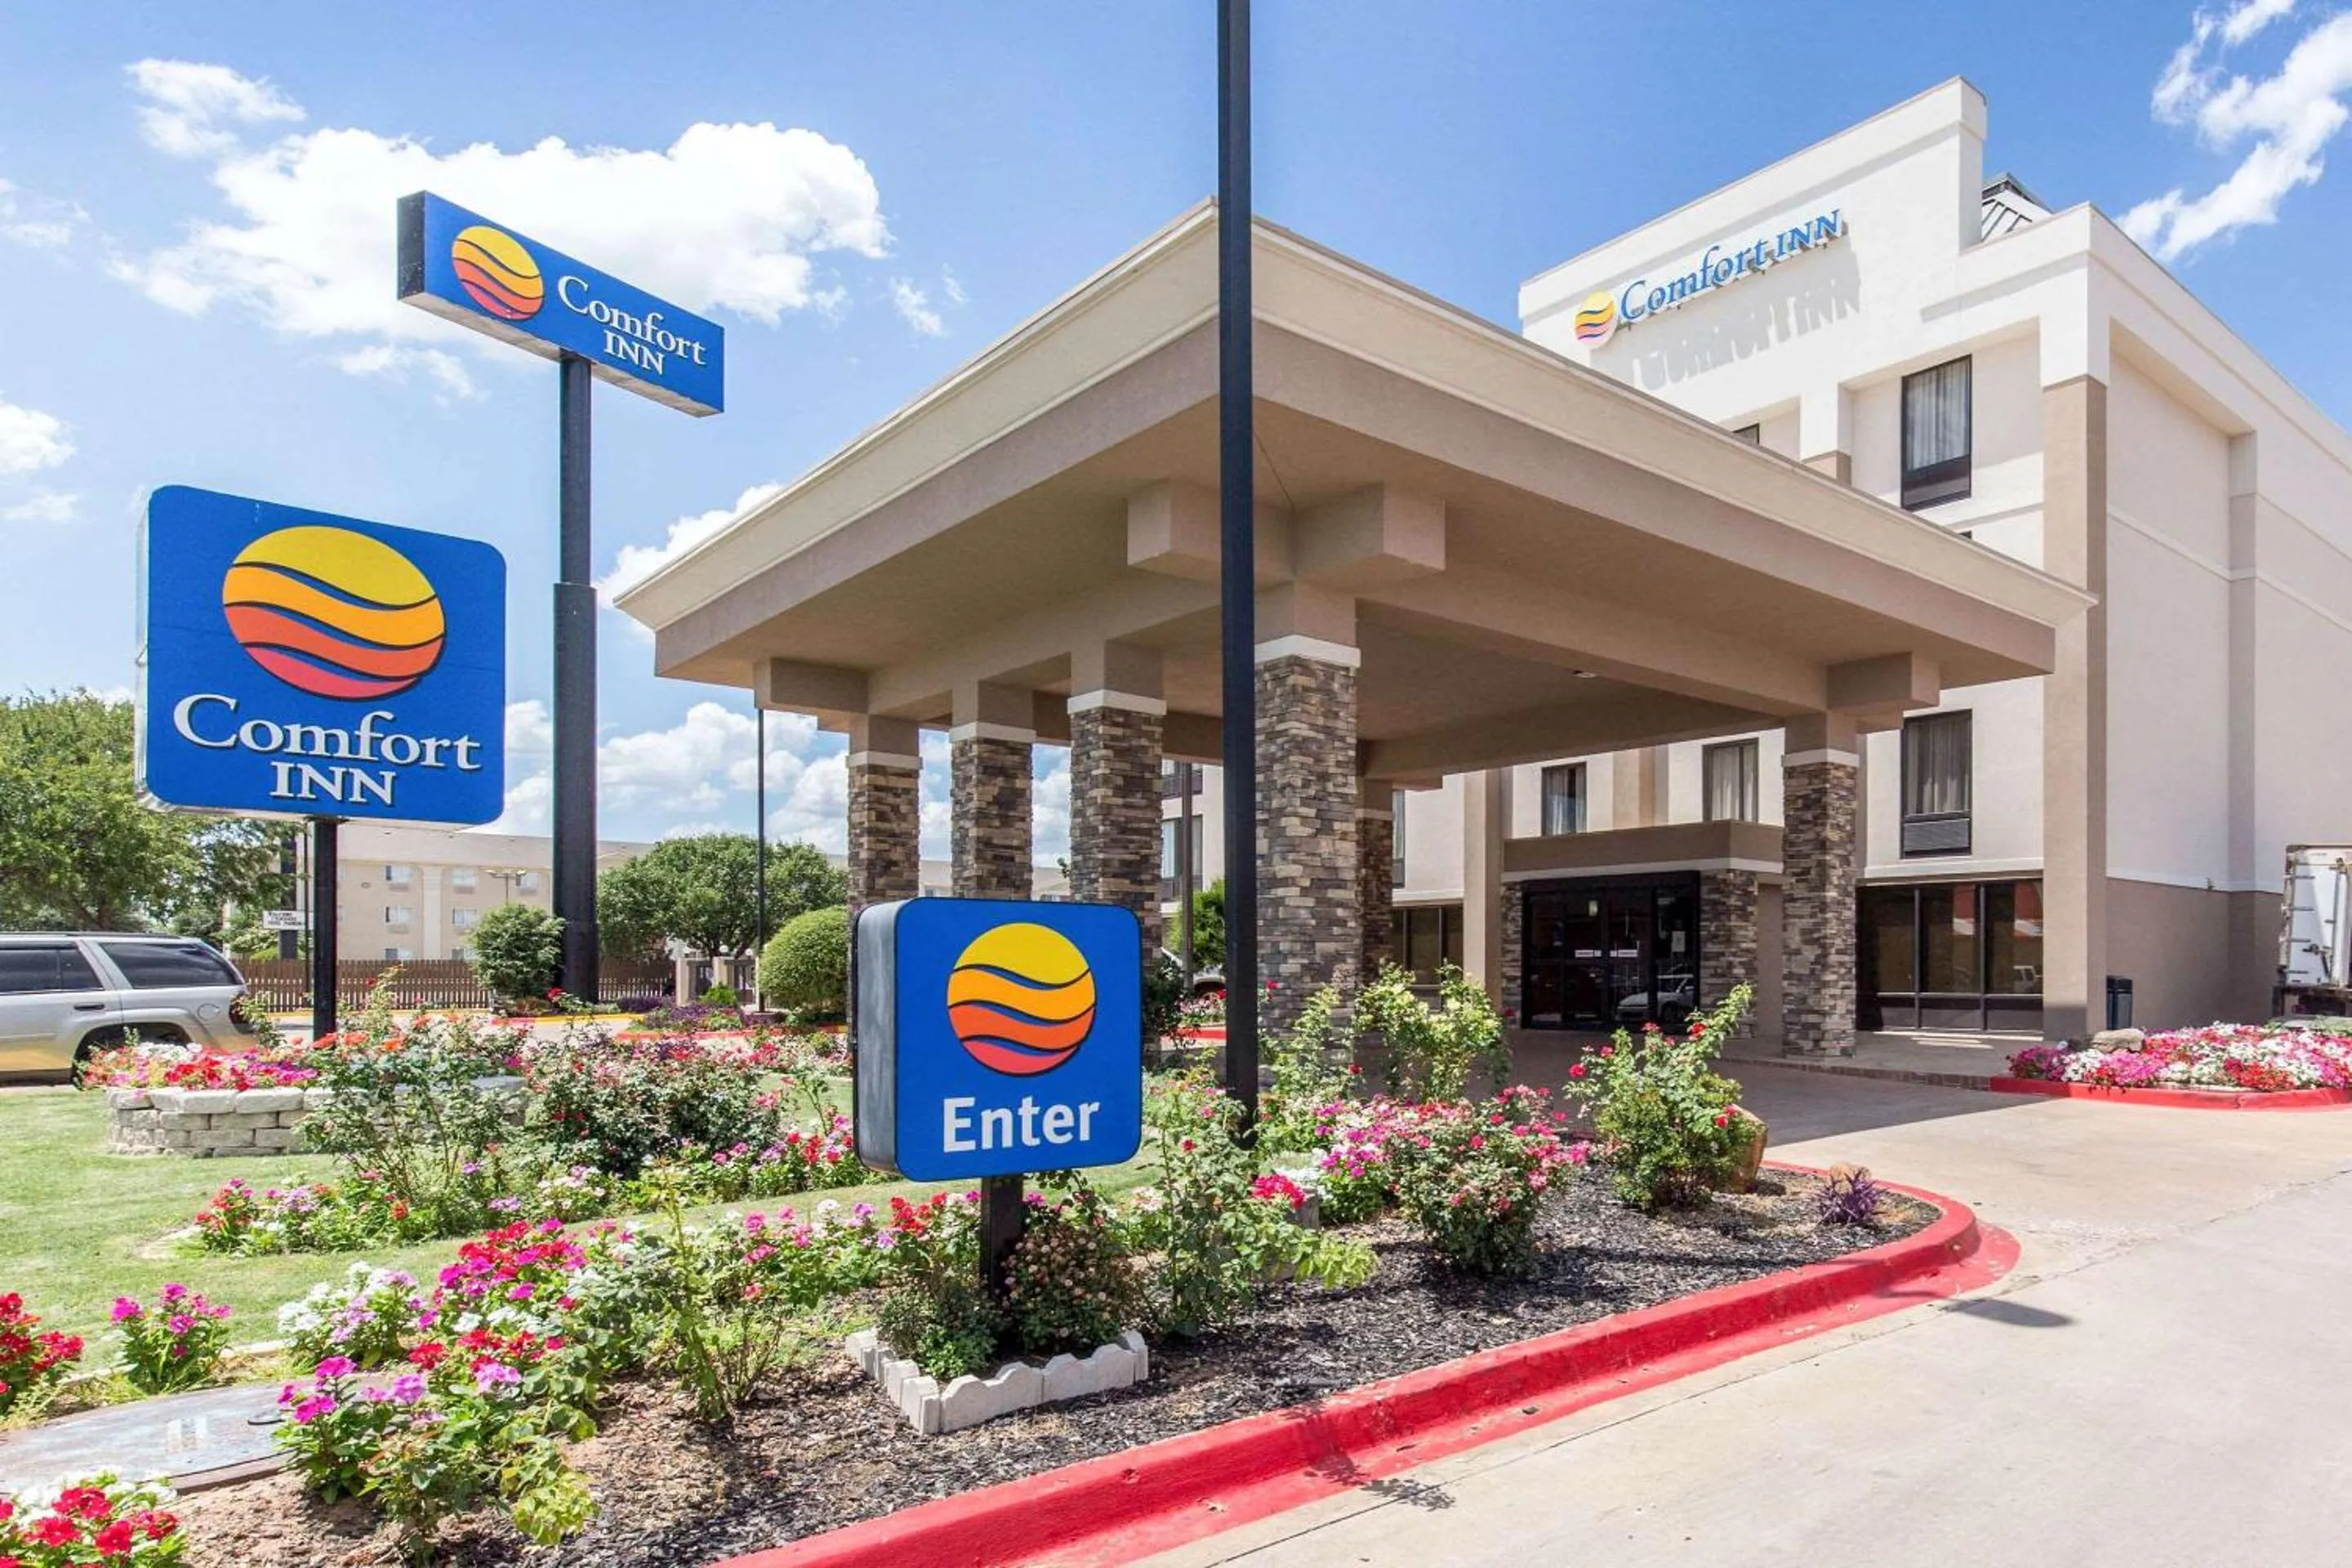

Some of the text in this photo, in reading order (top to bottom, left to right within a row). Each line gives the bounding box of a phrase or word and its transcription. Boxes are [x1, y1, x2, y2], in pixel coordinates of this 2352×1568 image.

[1621, 209, 1842, 321] Comfort INN
[558, 275, 706, 365] Comfort
[604, 331, 664, 375] INN
[173, 693, 480, 770] Comfort
[270, 761, 394, 806] INN
[942, 1094, 1100, 1153] Enter
